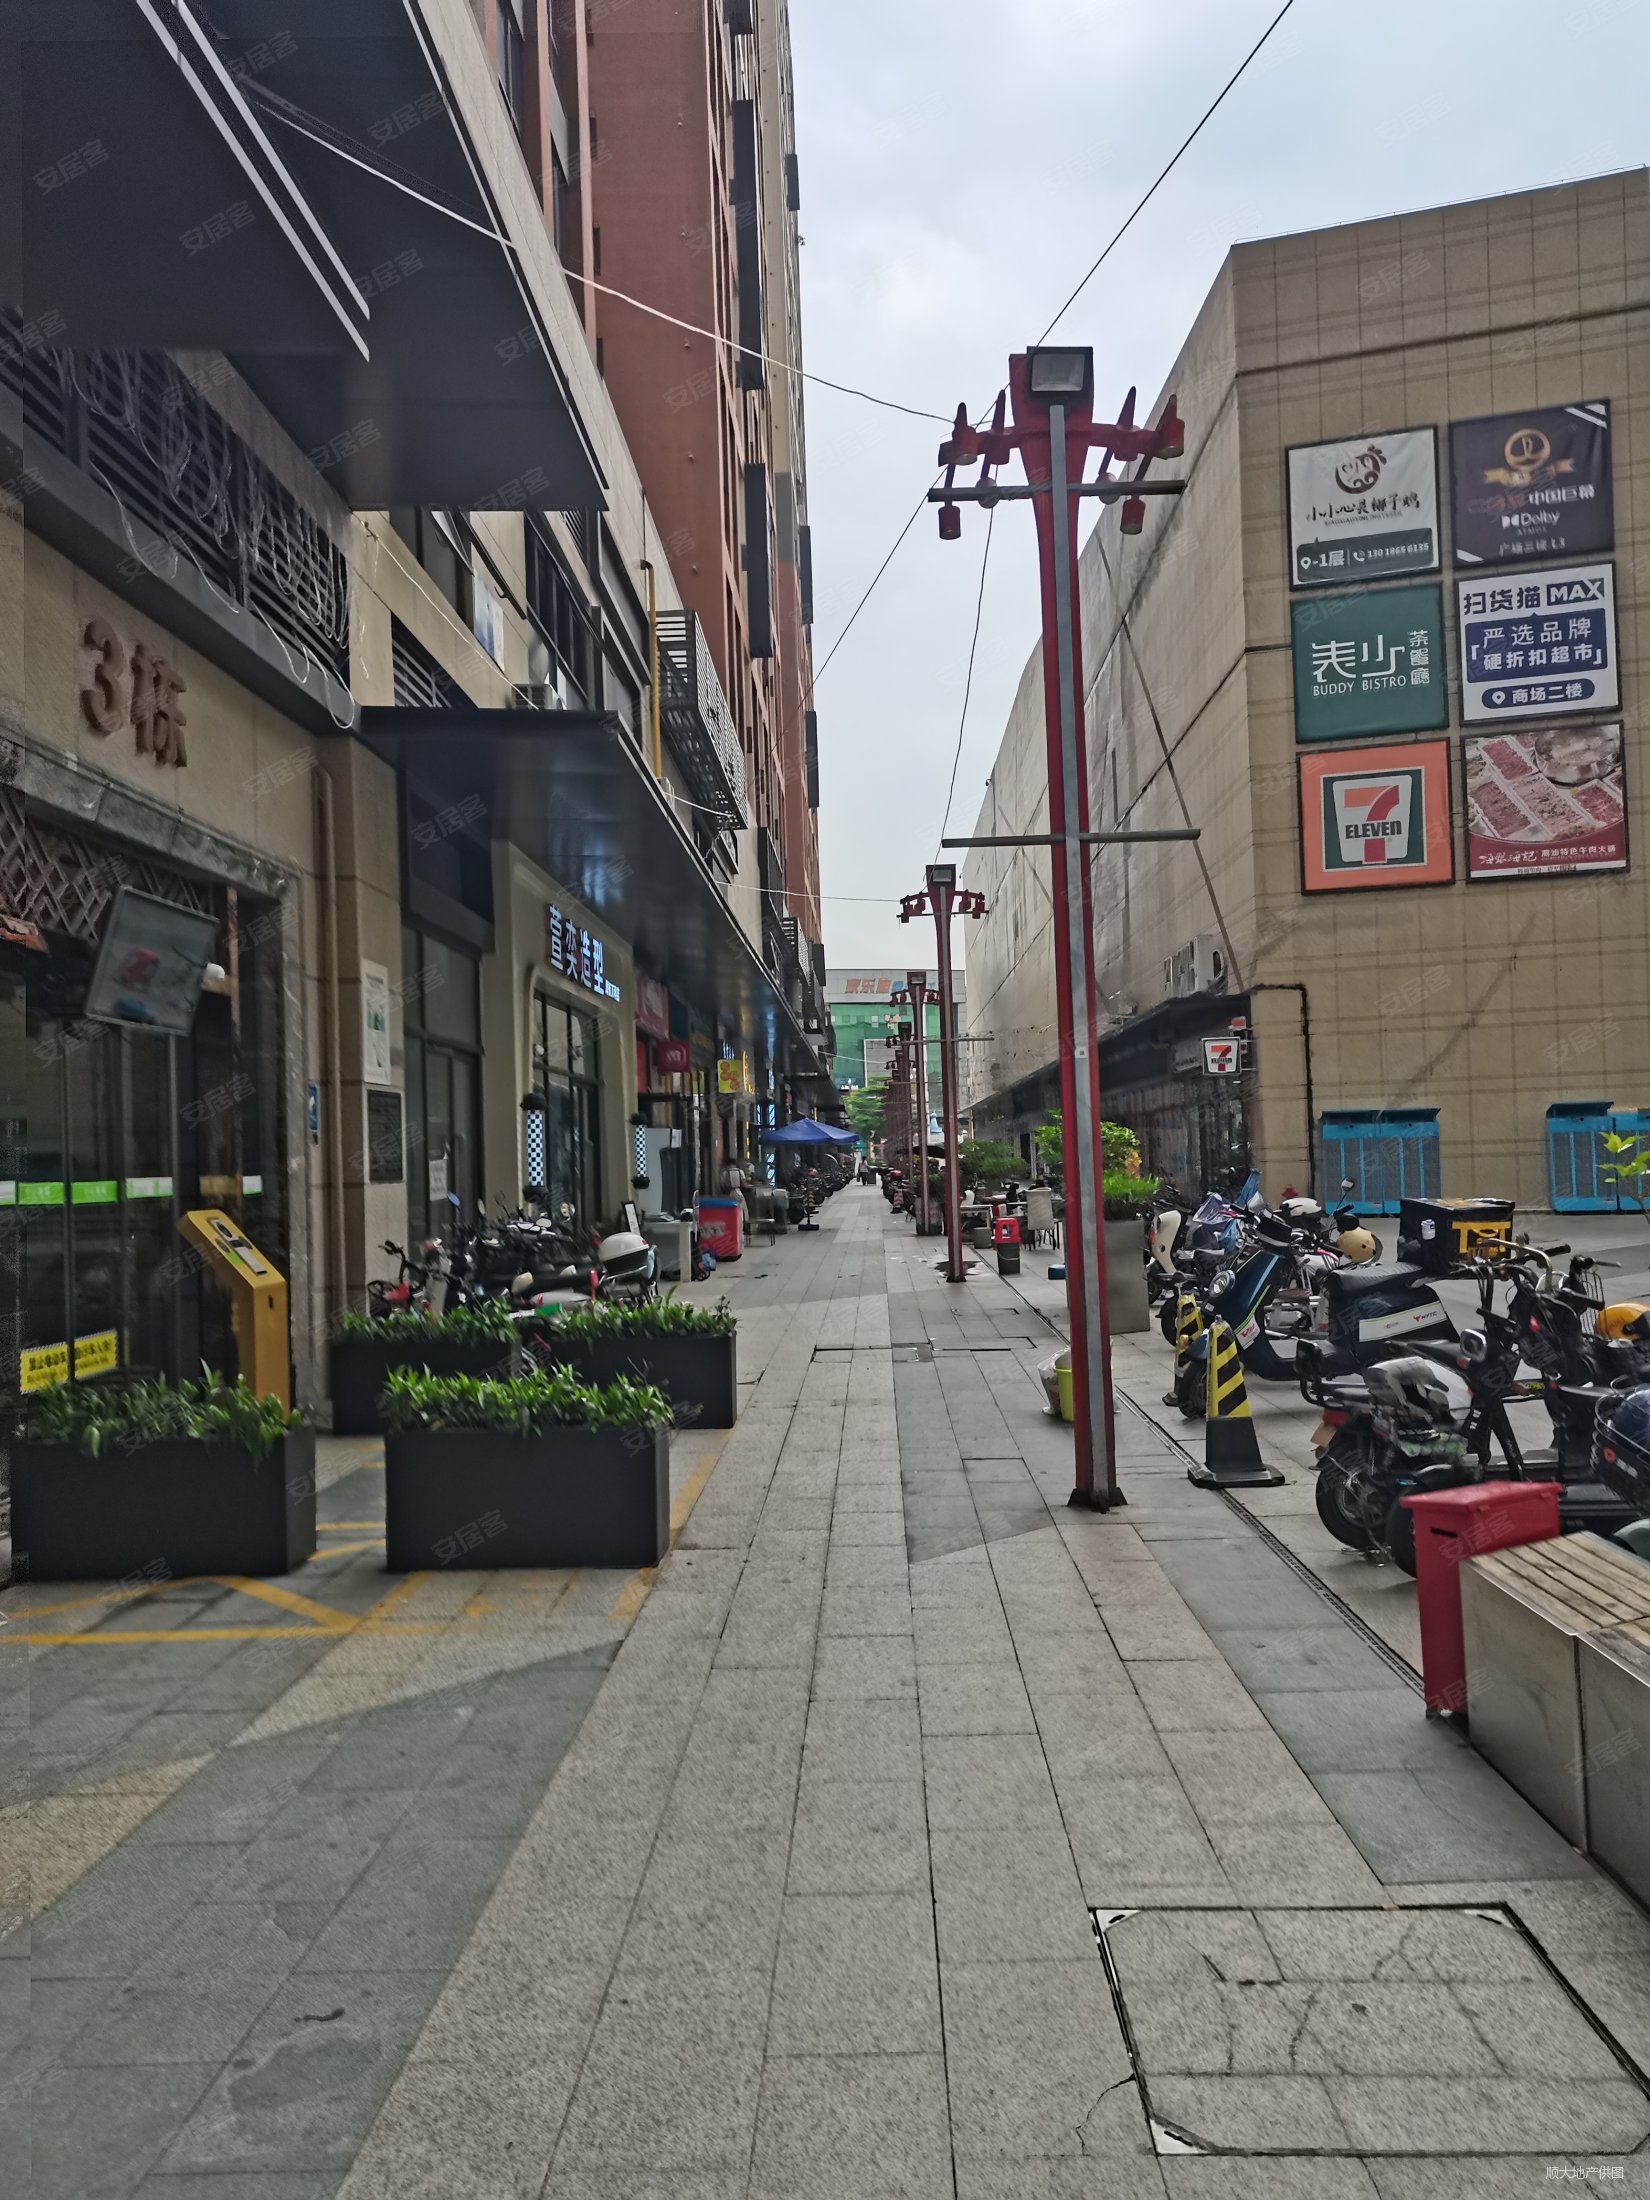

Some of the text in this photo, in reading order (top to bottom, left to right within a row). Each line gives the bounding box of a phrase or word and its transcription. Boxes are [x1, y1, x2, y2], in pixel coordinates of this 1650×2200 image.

[1521, 510, 1561, 527] Dolby
[1464, 578, 1604, 615] 扫货猫 MAX
[1483, 617, 1593, 649] 严选品牌
[1313, 675, 1407, 696] BUDDY BISTRO
[1512, 683, 1583, 704] 商场二楼
[1344, 785, 1399, 862] 7
[1211, 1045, 1231, 1071] 7
